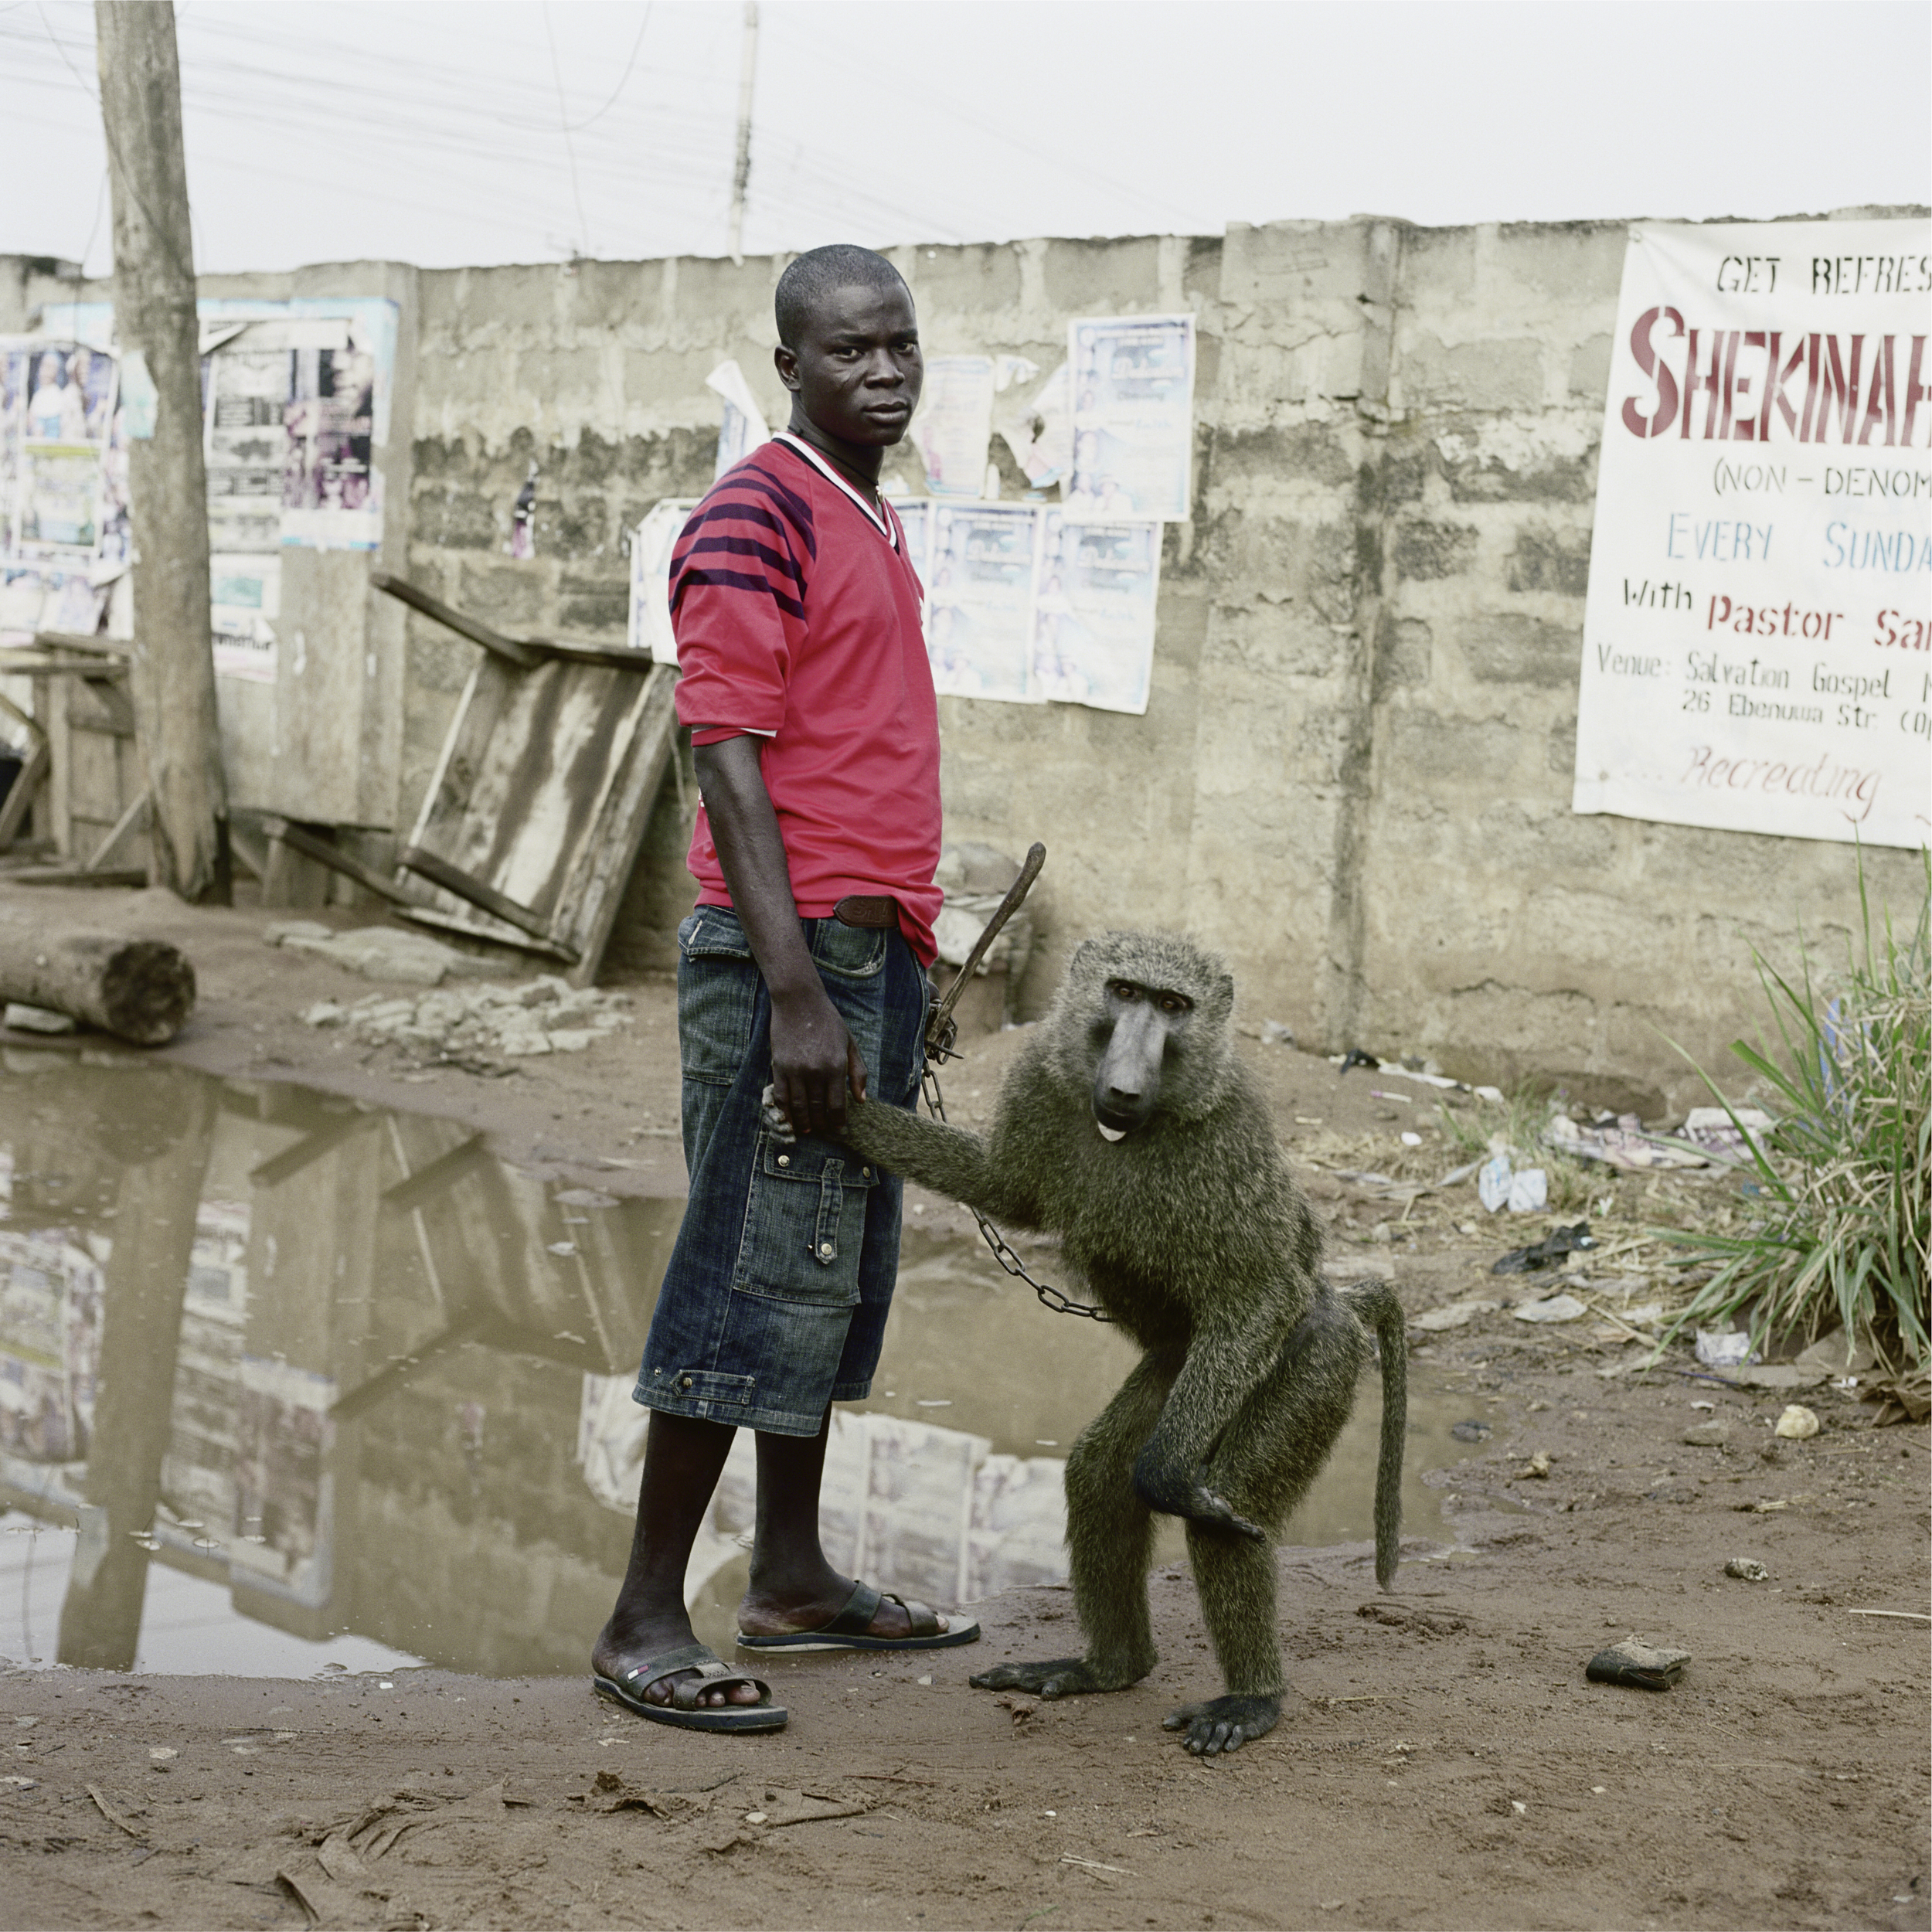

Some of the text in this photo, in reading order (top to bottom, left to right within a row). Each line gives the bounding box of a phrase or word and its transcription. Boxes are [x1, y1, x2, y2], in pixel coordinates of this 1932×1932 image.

[1717, 256, 1931, 294] GET REFRES
[1624, 579, 1692, 610] With
[1708, 596, 1844, 640] Pastor
[1597, 643, 1671, 677] Venue:
[1686, 651, 1789, 689] Salvation
[1814, 662, 1890, 700] Gospel
[1682, 689, 1710, 713] 26
[1681, 746, 1883, 823] Recreating
